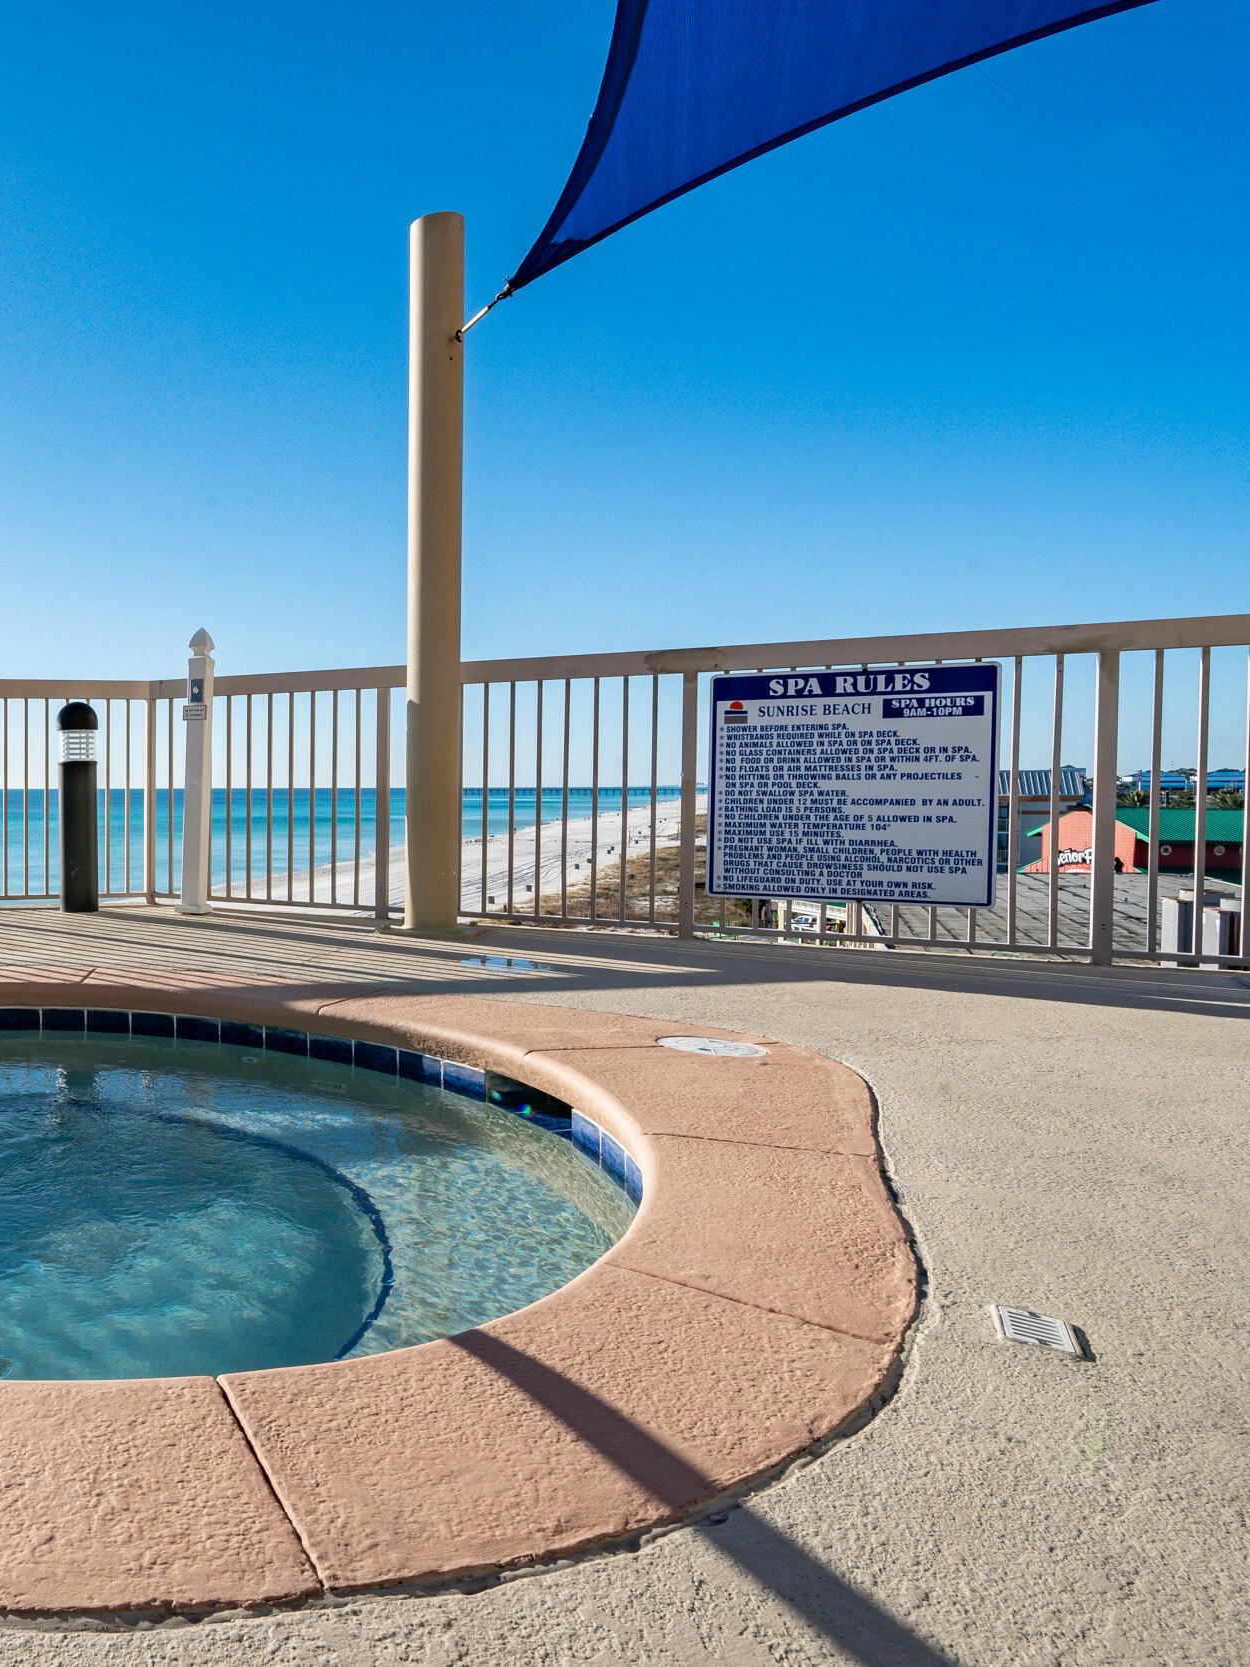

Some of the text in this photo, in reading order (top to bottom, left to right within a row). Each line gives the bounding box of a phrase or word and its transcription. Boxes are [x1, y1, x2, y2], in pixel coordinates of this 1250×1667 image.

[769, 672, 930, 696] SPA RULES
[892, 697, 975, 708] SPA HOURS
[758, 703, 871, 718] SUNRISE BEACH
[903, 707, 962, 716] 9AM-10PM
[791, 724, 829, 732] ENTERING
[776, 732, 815, 740] REQUIRED
[959, 754, 980, 762] SPA.
[802, 822, 866, 831] TEMPERATURE
[848, 839, 898, 847] DIARRHEA.
[880, 848, 913, 856] PEOPLE
[942, 850, 977, 858] HEALTH
[1058, 849, 1084, 865] eñor
[887, 856, 936, 865] NARCOTICS
[938, 858, 951, 866] OR
[953, 858, 983, 866] OTHER
[807, 862, 864, 871] DROWSINESS
[867, 864, 903, 872] SHOULD
[906, 865, 924, 873] NOT
[927, 866, 945, 874] USE
[948, 866, 967, 874] SPA
[763, 868, 816, 877] CONSULTING
[827, 870, 862, 879] DOCTOR
[737, 875, 782, 884] LIFEGUARD
[860, 880, 884, 888] YOUR
[887, 881, 908, 889] OWN
[912, 882, 936, 890] RISK.
[723, 883, 760, 891] SMOKING
[762, 884, 801, 893] ALLOWED
[804, 886, 826, 894] ONLY
[840, 888, 895, 897] DESIGNATED
[898, 890, 930, 898] AREAS.
